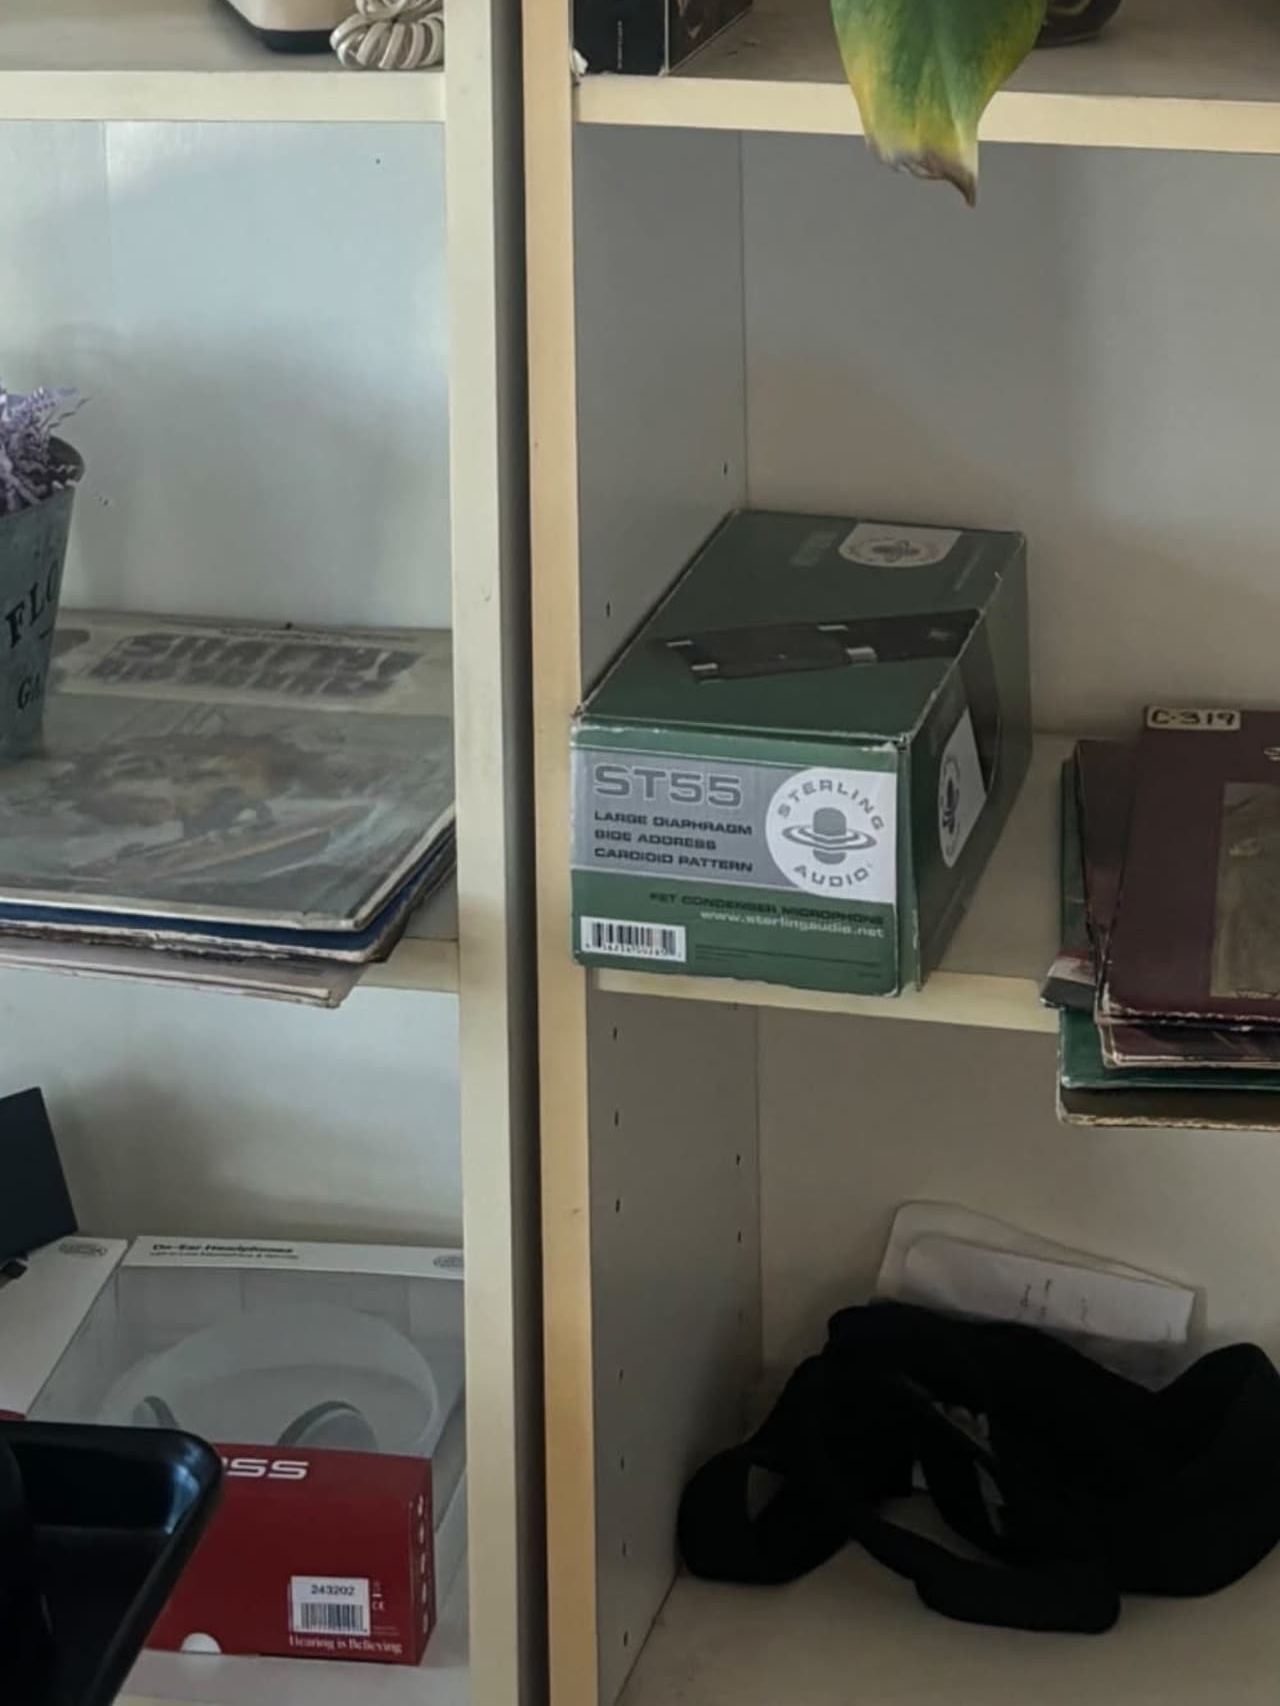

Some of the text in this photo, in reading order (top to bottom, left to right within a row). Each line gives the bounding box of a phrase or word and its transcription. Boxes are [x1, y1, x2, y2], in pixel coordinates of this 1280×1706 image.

[594, 763, 743, 809] ST55
[777, 778, 885, 830] STERLING
[594, 810, 753, 836] LARGE DIAPHRAGM
[594, 828, 718, 851] SIDE ADDRESS
[594, 847, 753, 872] CARDIOID PATTERN
[793, 864, 870, 888] AUDIO
[681, 894, 778, 914] CONDENSER
[780, 905, 884, 926] MICROPHONE
[700, 910, 885, 939] www.sterlingaudio.net
[221, 1456, 310, 1480] SS
[289, 1635, 403, 1655] Hearing is Believing
